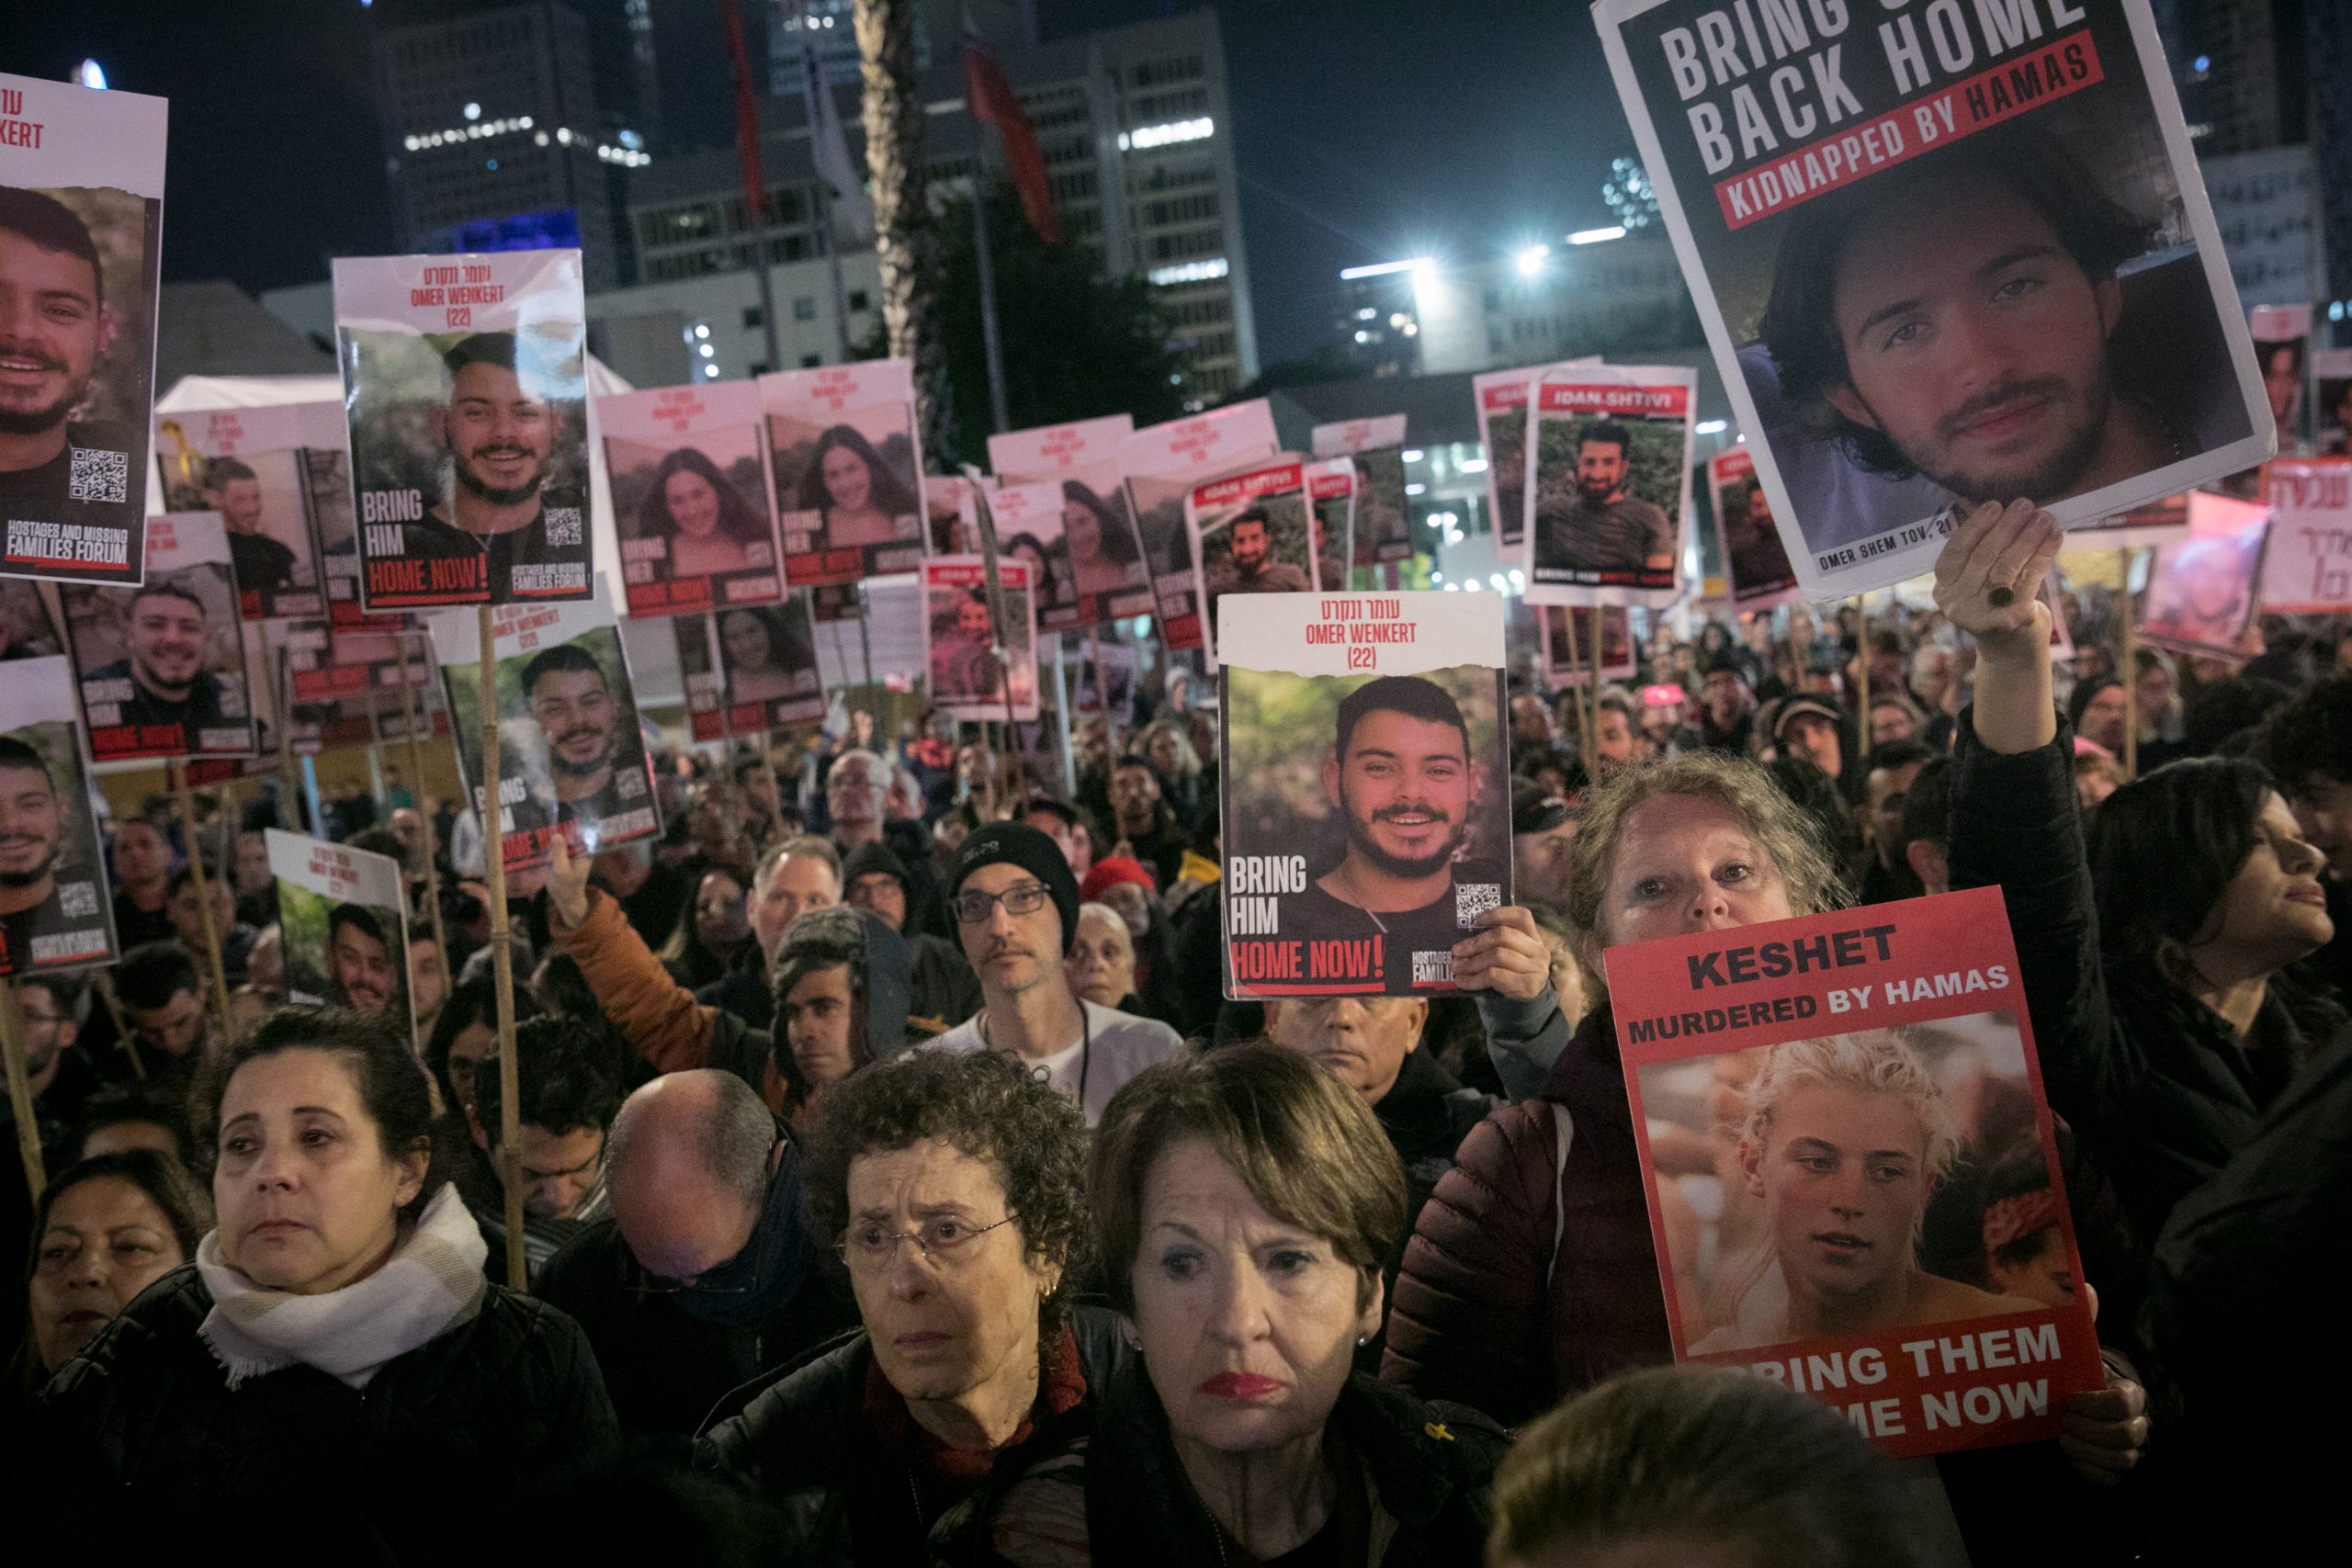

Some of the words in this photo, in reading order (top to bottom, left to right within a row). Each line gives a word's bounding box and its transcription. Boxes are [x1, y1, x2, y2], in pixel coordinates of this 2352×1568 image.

[1660, 0, 1849, 101] BRING
[1687, 44, 1864, 175] BACK
[0, 119, 44, 150] KERT
[1727, 118, 1905, 220] KIDNAPPED
[1914, 95, 1956, 144] BY
[1964, 42, 2088, 123] HAMAS
[463, 265, 492, 284] עומר
[411, 288, 444, 307] OMER
[447, 285, 503, 305] WENKERT
[446, 307, 471, 329] (22)
[1555, 389, 1602, 405] IDAN
[1606, 390, 1672, 409] SHTIVI
[361, 488, 424, 525] BRING
[6, 535, 73, 560] FAMILIES
[75, 540, 128, 564] FORUM
[8, 520, 60, 539] HOSTAGES
[61, 525, 82, 540] AND
[84, 526, 129, 545] MISSING
[365, 524, 404, 557] HIM
[1819, 548, 1857, 571] OMER
[1859, 536, 1897, 559] SHEM
[1899, 525, 1933, 546] TOV,
[1936, 518, 1953, 535] 21
[368, 558, 427, 592] HOME
[430, 551, 488, 590] NOW!
[1321, 600, 1362, 622] ונקרט
[1366, 599, 1400, 620] עומר
[1306, 624, 1346, 645] OMER
[1349, 622, 1417, 644] WENKERT
[1348, 646, 1376, 670] (22)
[1229, 854, 1306, 895] BRING
[1230, 897, 1279, 936] HIM
[1231, 941, 1304, 980] HOME
[1310, 934, 1385, 979] NOW!
[1412, 951, 1452, 965] HOSTAGES
[1687, 924, 1896, 990] KESHET
[1628, 995, 1817, 1044] MURDERED
[1827, 985, 1872, 1014] BY
[1884, 965, 2009, 1005] HAMAS
[1732, 1347, 1888, 1393] RING
[1901, 1324, 2062, 1378] THEM
[1920, 1378, 2049, 1431] NOW
